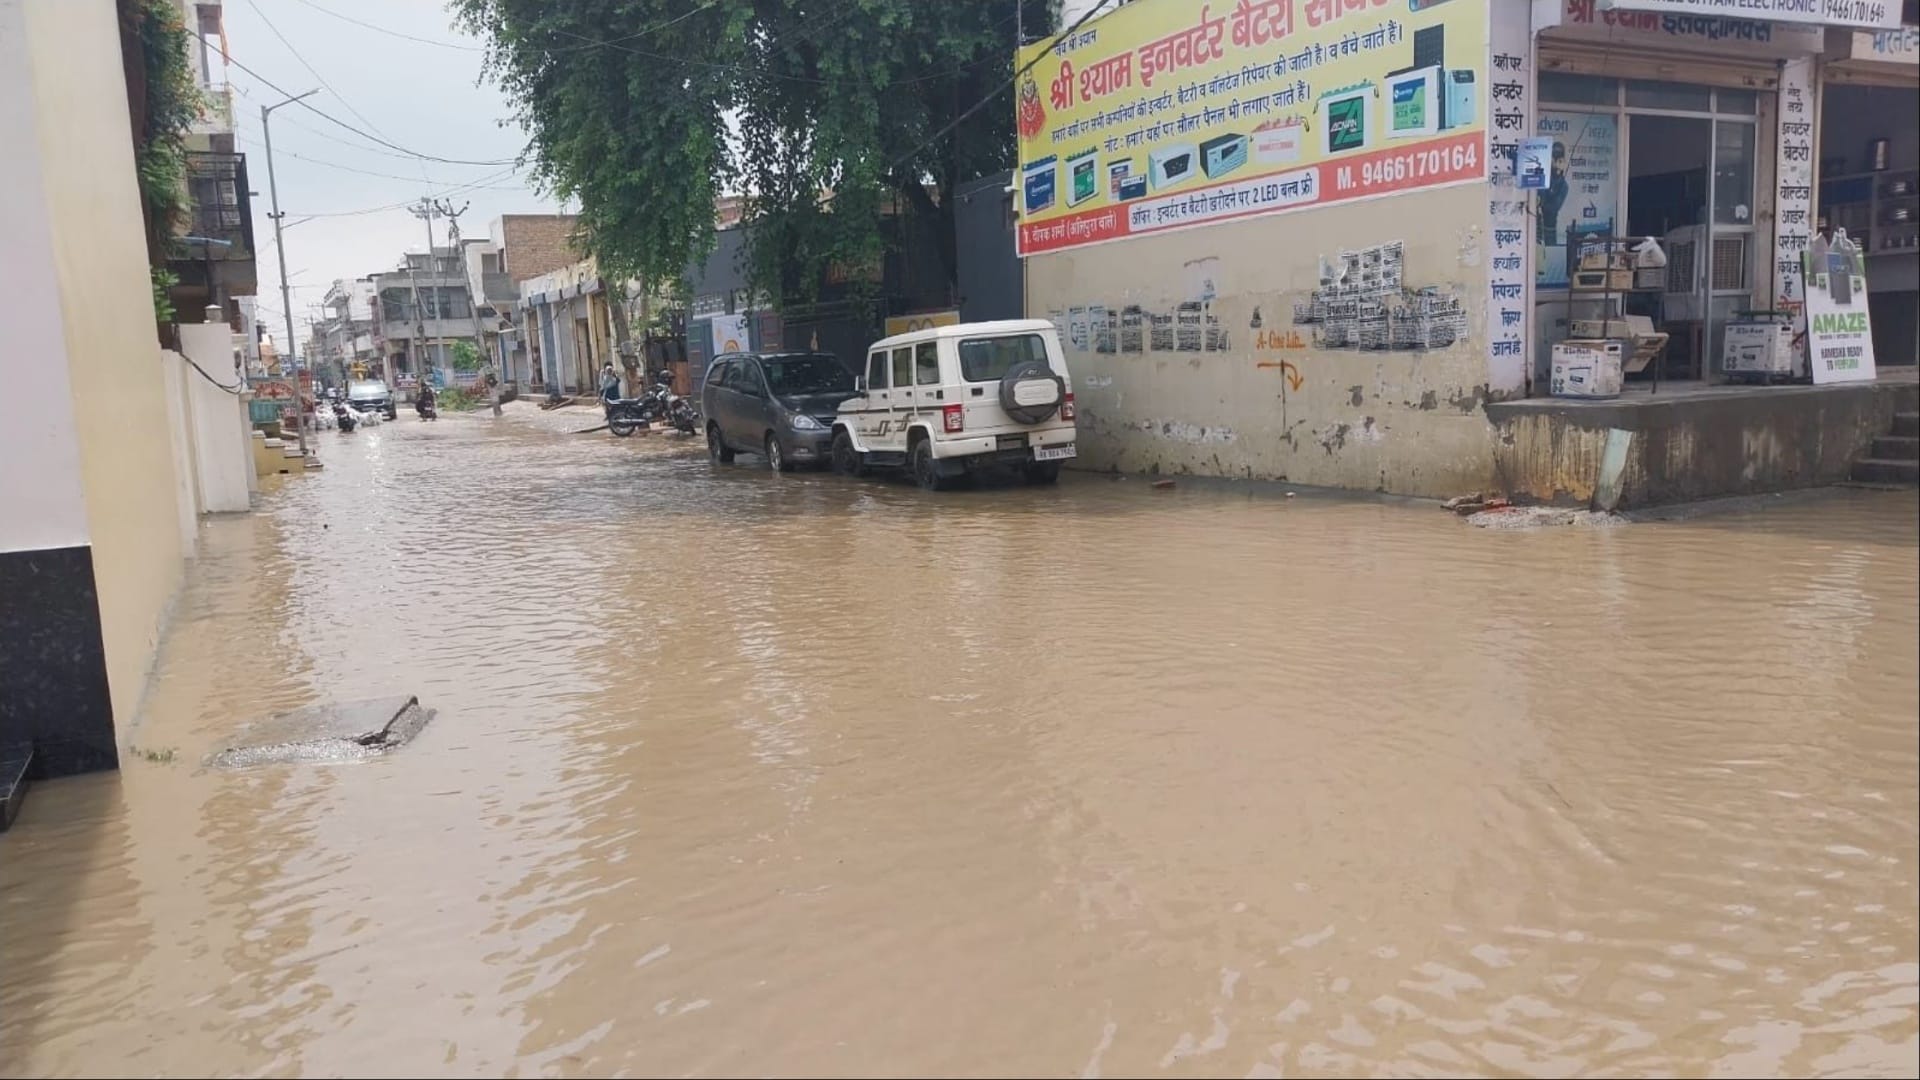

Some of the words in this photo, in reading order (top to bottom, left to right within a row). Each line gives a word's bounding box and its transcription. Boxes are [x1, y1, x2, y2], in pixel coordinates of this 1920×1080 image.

[1050, 60, 1075, 111] श्री
[1080, 51, 1133, 102] श्याम
[1139, 4, 1226, 87] इनवर्टर
[1178, 78, 1198, 104] बैटरी
[1242, 65, 1271, 88] रिपेयर
[1274, 54, 1287, 77] की
[1289, 45, 1313, 71] जाती
[1329, 43, 1338, 60] व
[1341, 31, 1359, 56] बेचे
[1362, 26, 1385, 50] जाते
[1510, 56, 1522, 72] पर
[1492, 79, 1523, 102] इन्वर्टर
[1126, 128, 1145, 148] हमारे
[1163, 121, 1174, 137] पर
[1202, 103, 1225, 127] पैनल
[1228, 99, 1240, 120] भी
[1242, 93, 1270, 116] लगाए
[1273, 83, 1295, 110] जाते
[1337, 166, 1357, 191] M.
[1362, 142, 1478, 187] 9466170164
[1189, 193, 1207, 215] बैटरी
[1209, 189, 1237, 213] खरीदने
[1238, 189, 1250, 205] पर
[1252, 187, 1259, 204] 2
[1260, 184, 1279, 202] LED
[1300, 172, 1314, 197] फ्री
[1812, 312, 1868, 334] AMAZE
